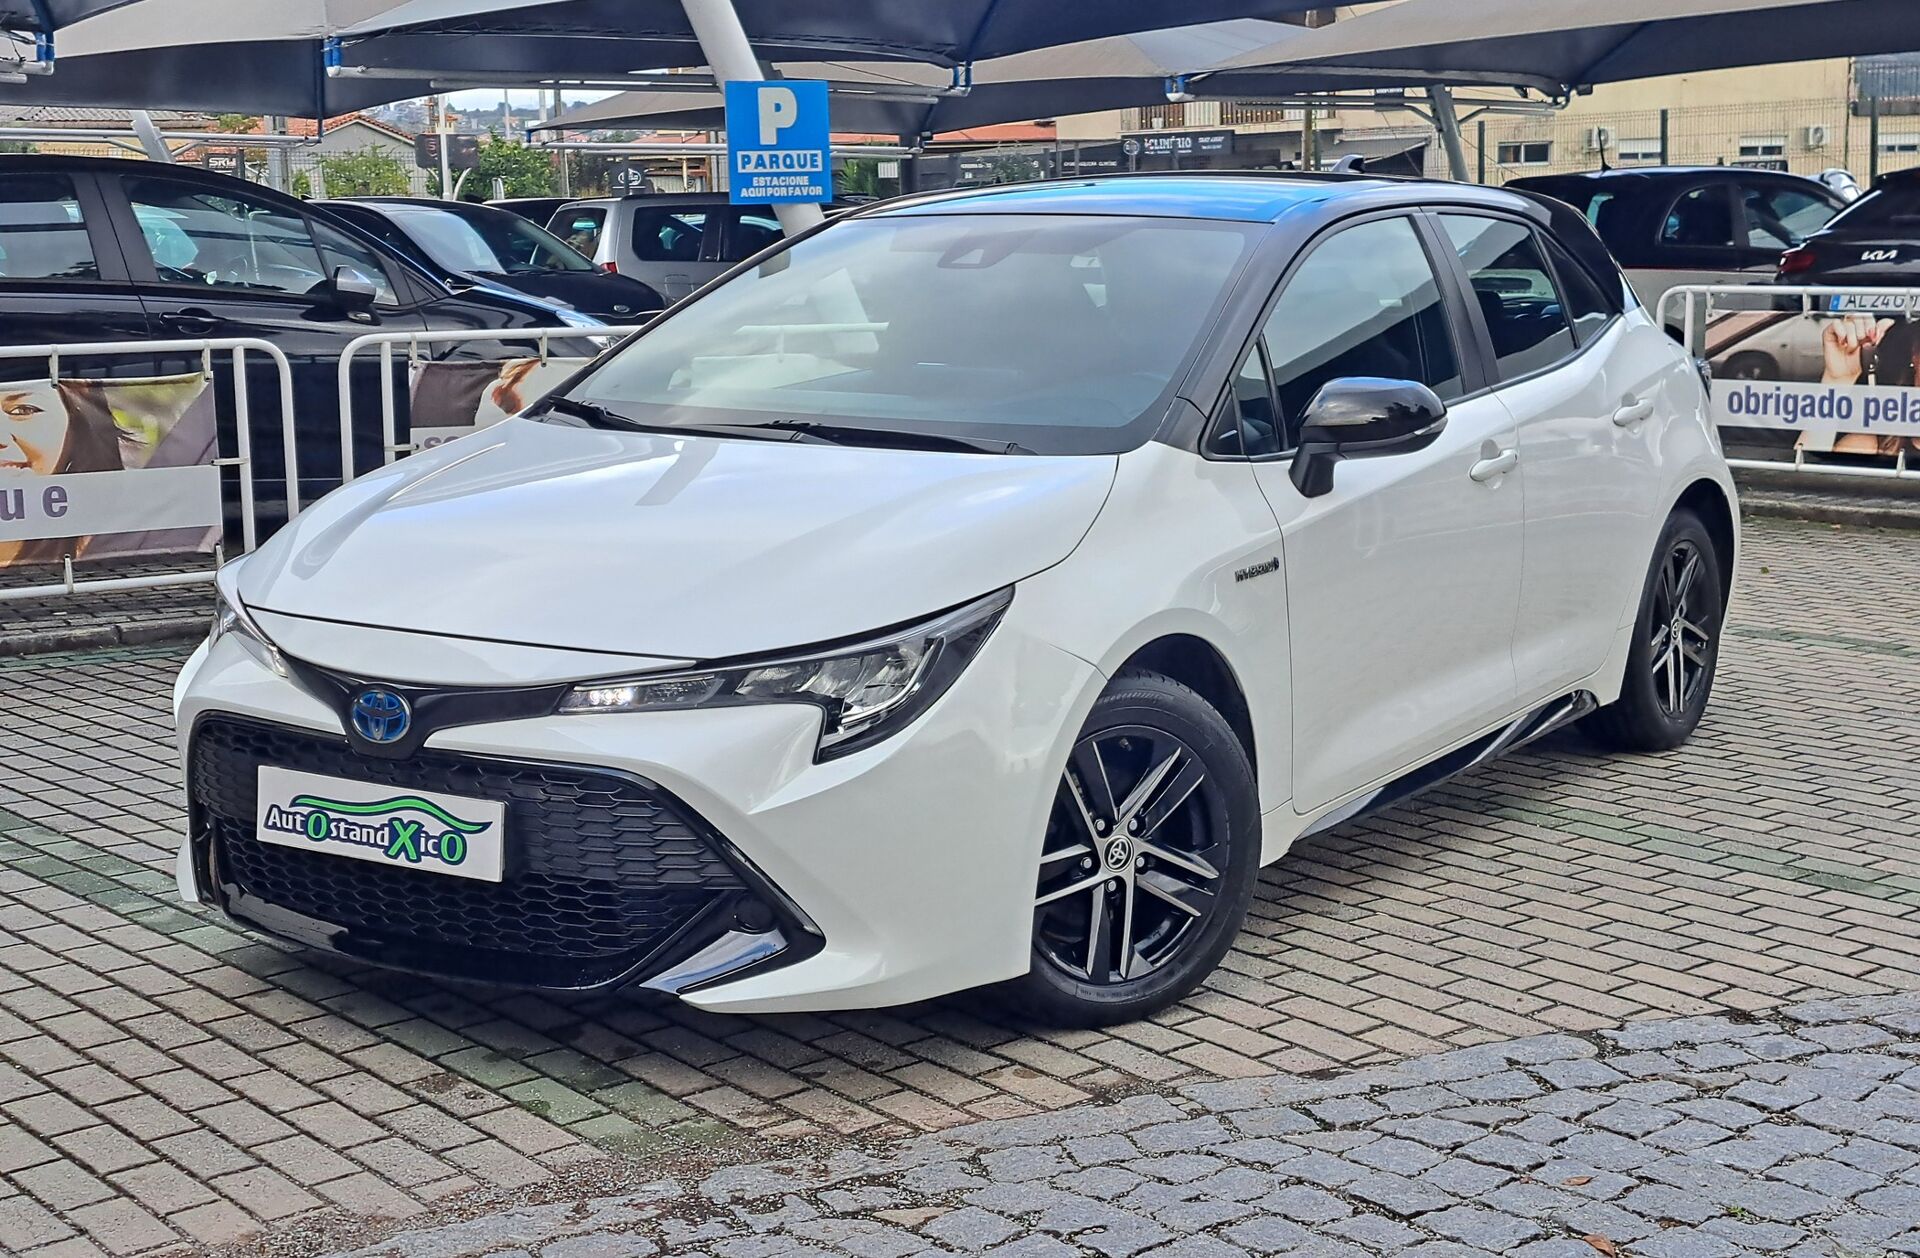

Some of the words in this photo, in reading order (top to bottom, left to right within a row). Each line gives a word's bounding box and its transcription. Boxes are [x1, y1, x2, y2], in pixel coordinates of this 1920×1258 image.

[757, 87, 798, 146] P
[740, 153, 819, 170] PARQUE
[752, 176, 809, 187] ESTACIONE
[1861, 249, 1898, 261] KIA
[1844, 294, 1867, 308] AL
[1727, 385, 1853, 424] obrigado
[1862, 391, 1920, 428] pela
[42, 485, 68, 518] e
